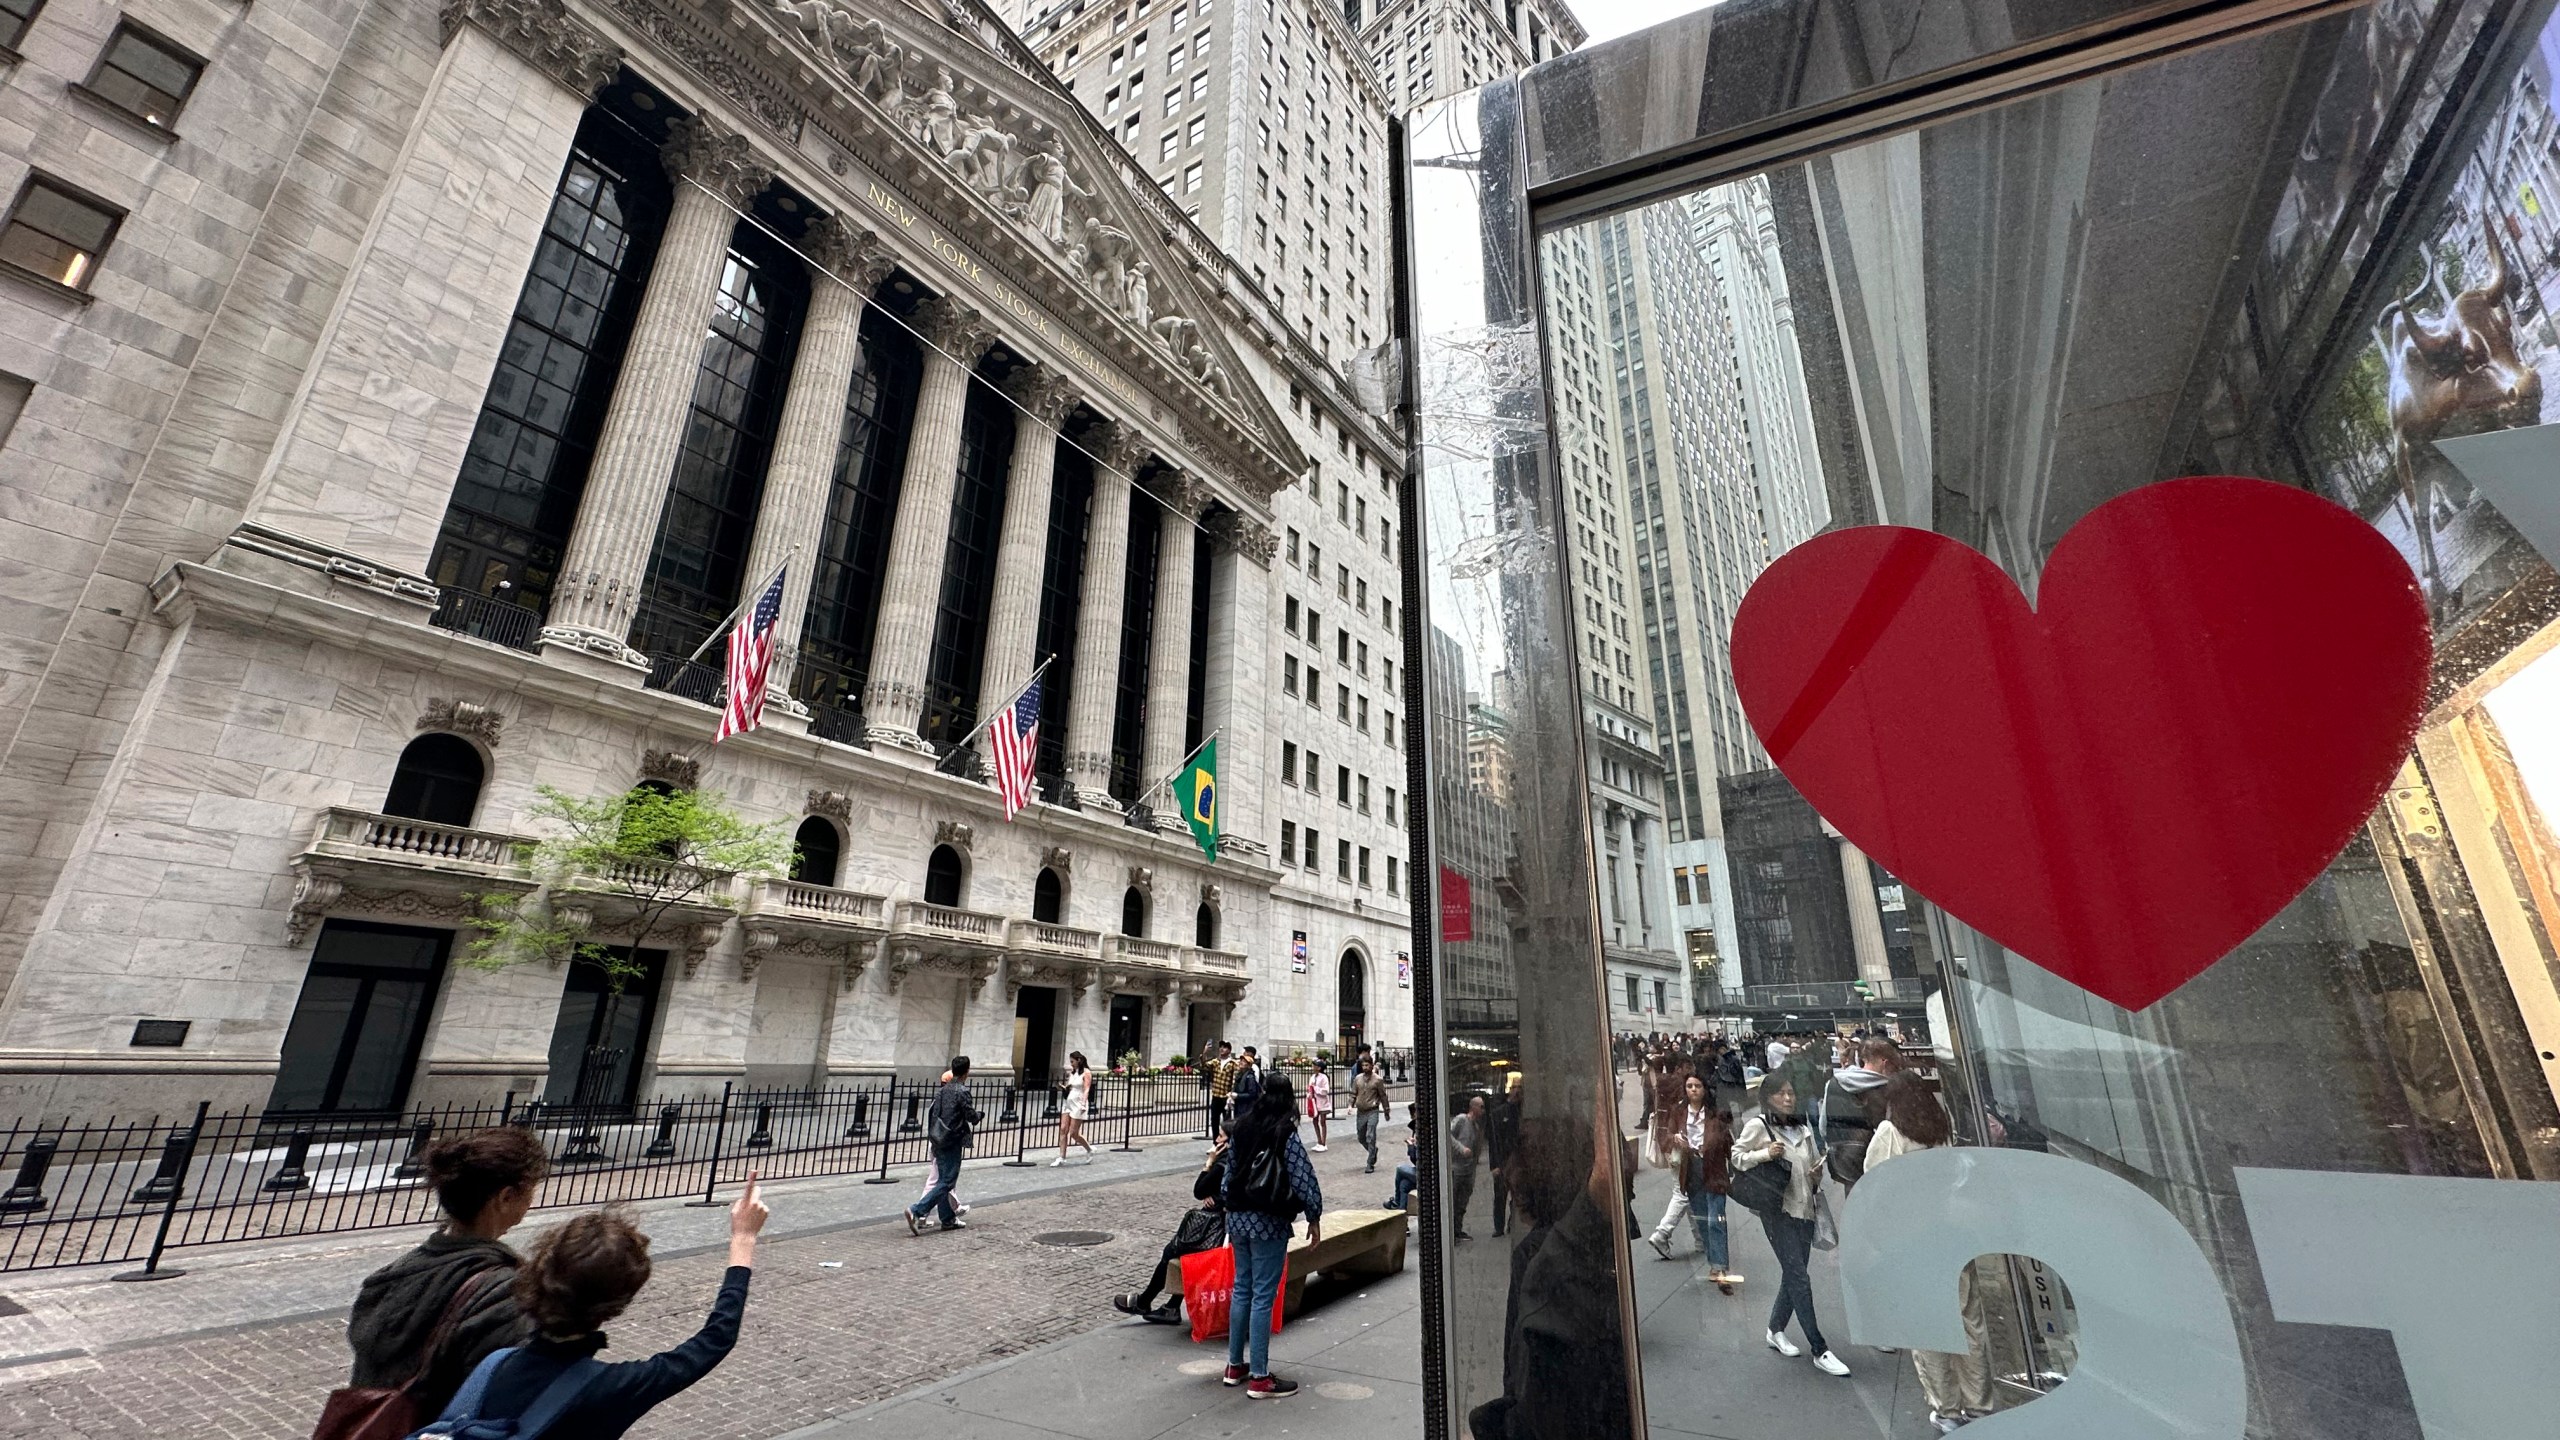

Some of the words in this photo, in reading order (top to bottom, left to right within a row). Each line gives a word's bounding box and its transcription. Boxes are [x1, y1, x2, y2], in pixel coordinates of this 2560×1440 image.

[867, 182, 917, 228] NEW
[929, 230, 983, 285] YORK
[994, 283, 1050, 337] STOCK
[1058, 333, 1139, 406] EXCHANGE
